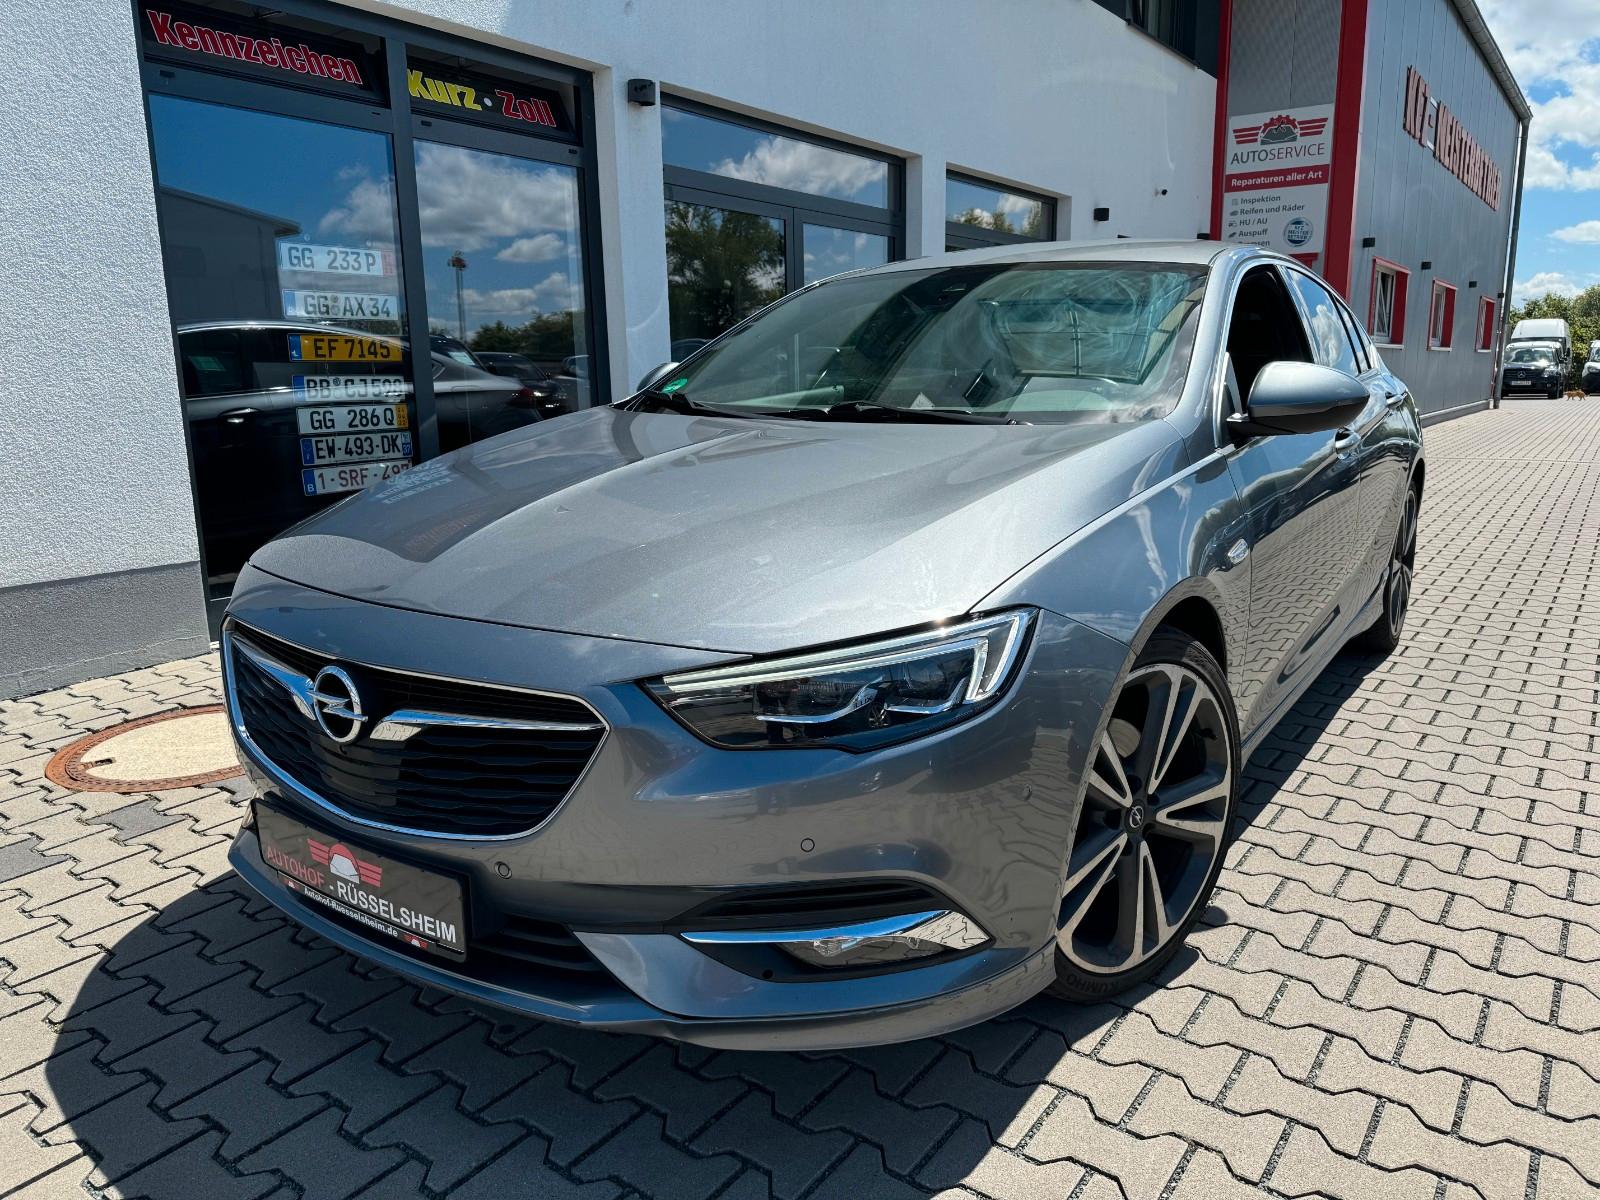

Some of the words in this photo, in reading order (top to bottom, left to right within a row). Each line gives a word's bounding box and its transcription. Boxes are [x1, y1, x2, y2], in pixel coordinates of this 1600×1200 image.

[147, 10, 363, 85] Kennzeichen
[407, 69, 483, 111] Kurz
[496, 89, 557, 128] Zoll
[1231, 143, 1325, 165] AUTOSERVICE
[1231, 175, 1285, 188] Reparaturen
[1286, 173, 1306, 182] aller
[1307, 171, 1322, 179] Art
[1240, 208, 1264, 216] Reifen
[1282, 204, 1305, 212] Räder
[1241, 195, 1281, 206] Inspektion
[1239, 218, 1251, 226] HU
[1256, 217, 1268, 225] AU
[1238, 228, 1268, 238] Auspuff
[288, 246, 315, 269] GG
[327, 249, 362, 271] 233
[304, 294, 330, 316] GG
[343, 296, 366, 317] AX
[369, 297, 391, 318] 34
[313, 338, 338, 358] EF
[345, 338, 390, 359] 7145
[306, 378, 331, 398] BB
[310, 410, 336, 431] GG
[347, 407, 380, 429] 286
[383, 407, 394, 426] Q
[266, 846, 326, 887] AUTOHOF
[336, 880, 457, 943] RÜSSELSHEIM
